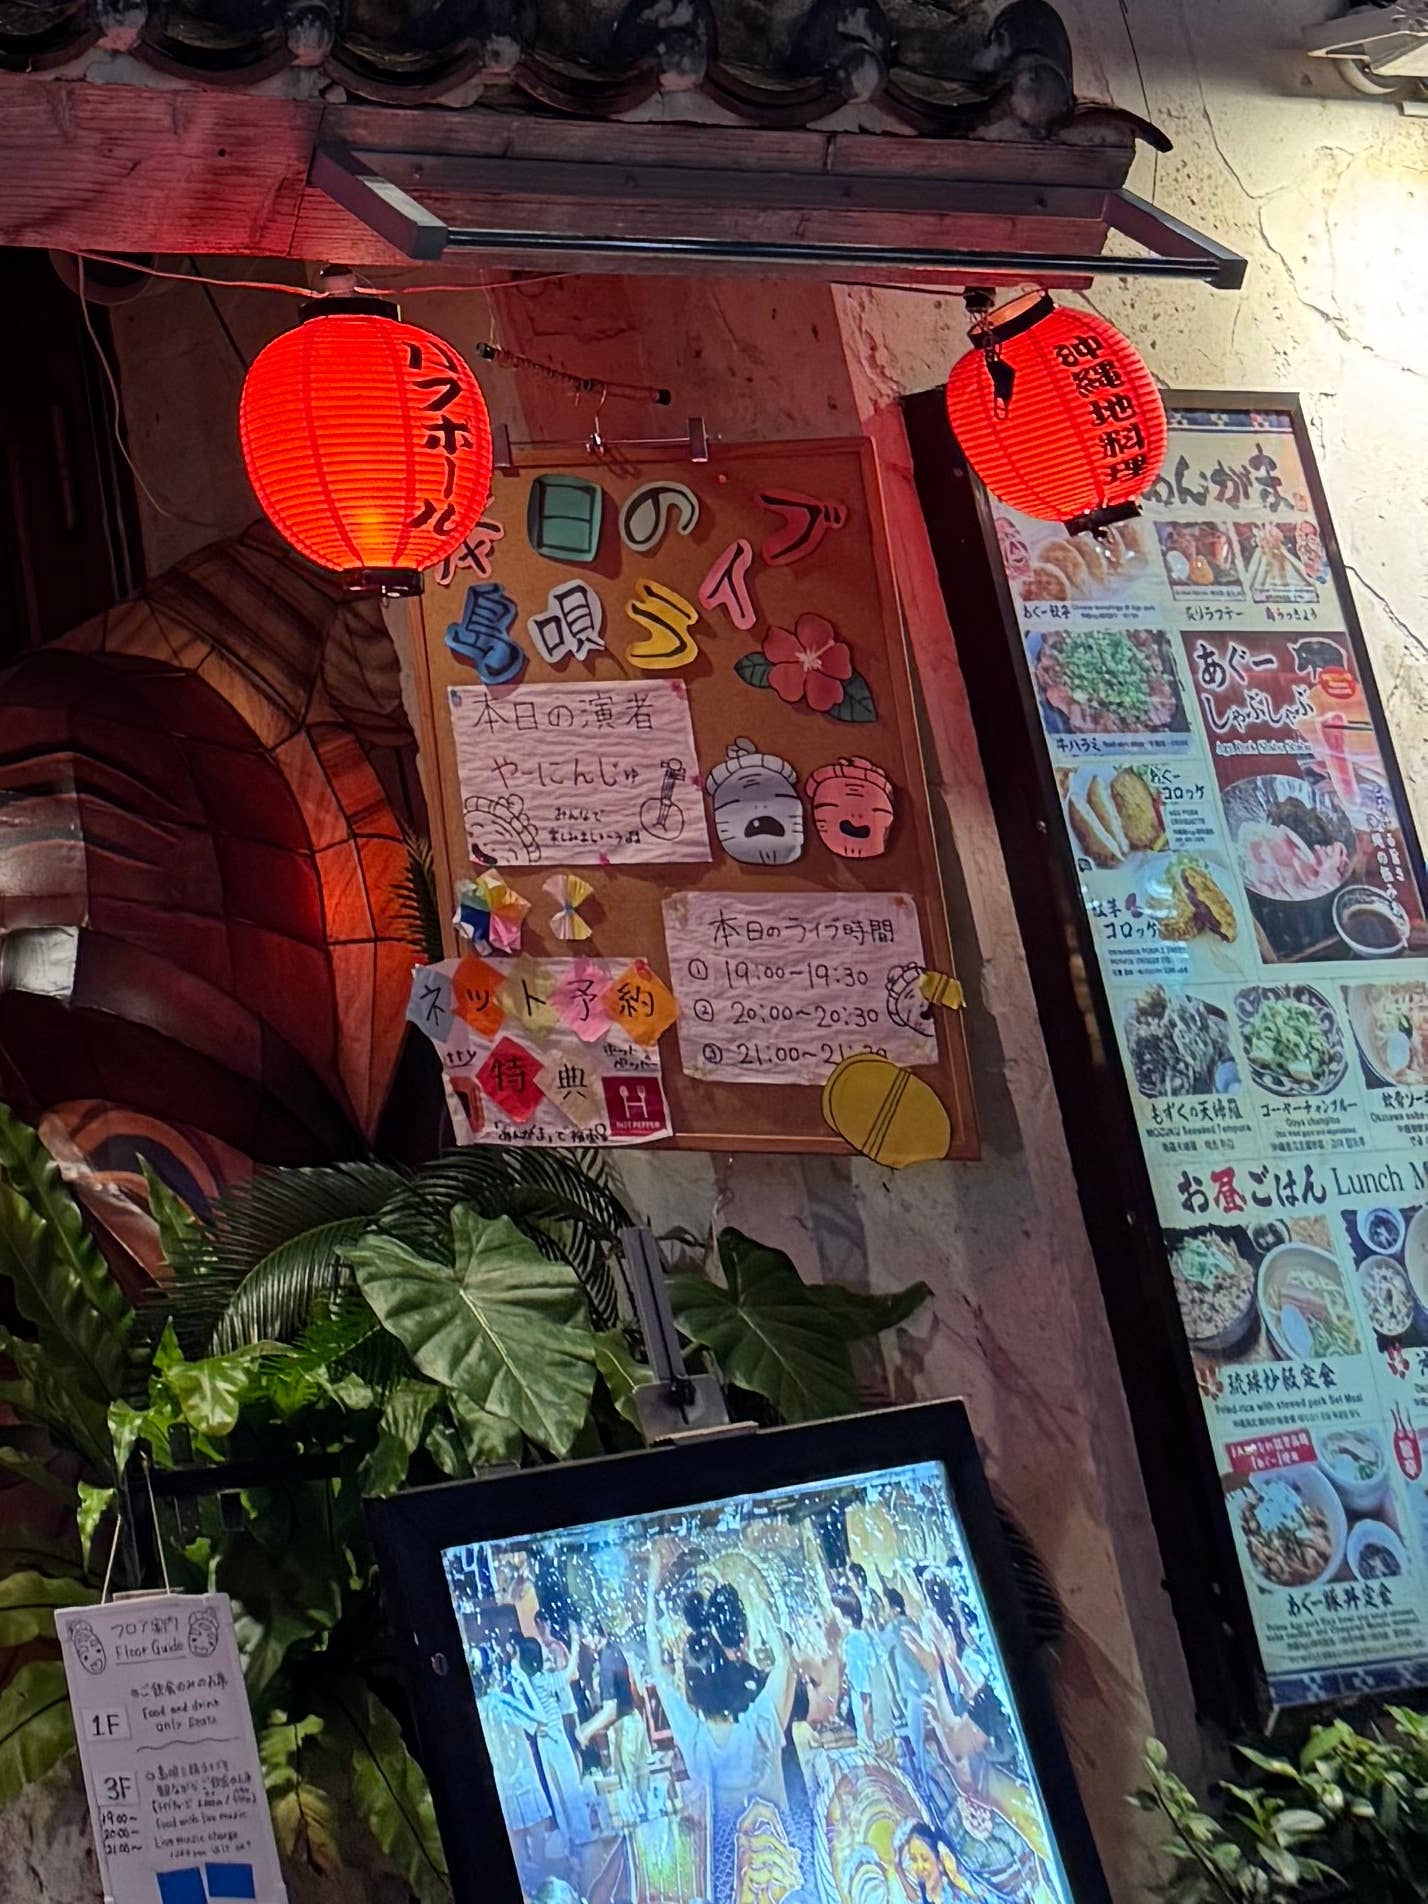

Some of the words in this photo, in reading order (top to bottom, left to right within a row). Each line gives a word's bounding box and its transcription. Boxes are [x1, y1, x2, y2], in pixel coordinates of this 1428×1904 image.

[472, 691, 655, 734] 本日の演者
[1162, 784, 1205, 800] コロッケ
[709, 909, 895, 948] 本日のライブ時間
[419, 978, 656, 1026] ネット予約
[494, 1057, 588, 1100] 特典
[1177, 1163, 1327, 1214] お昼ごはん
[1330, 1164, 1404, 1196] Lunch
[91, 1714, 120, 1736] 1F
[103, 1776, 132, 1801] 3F
